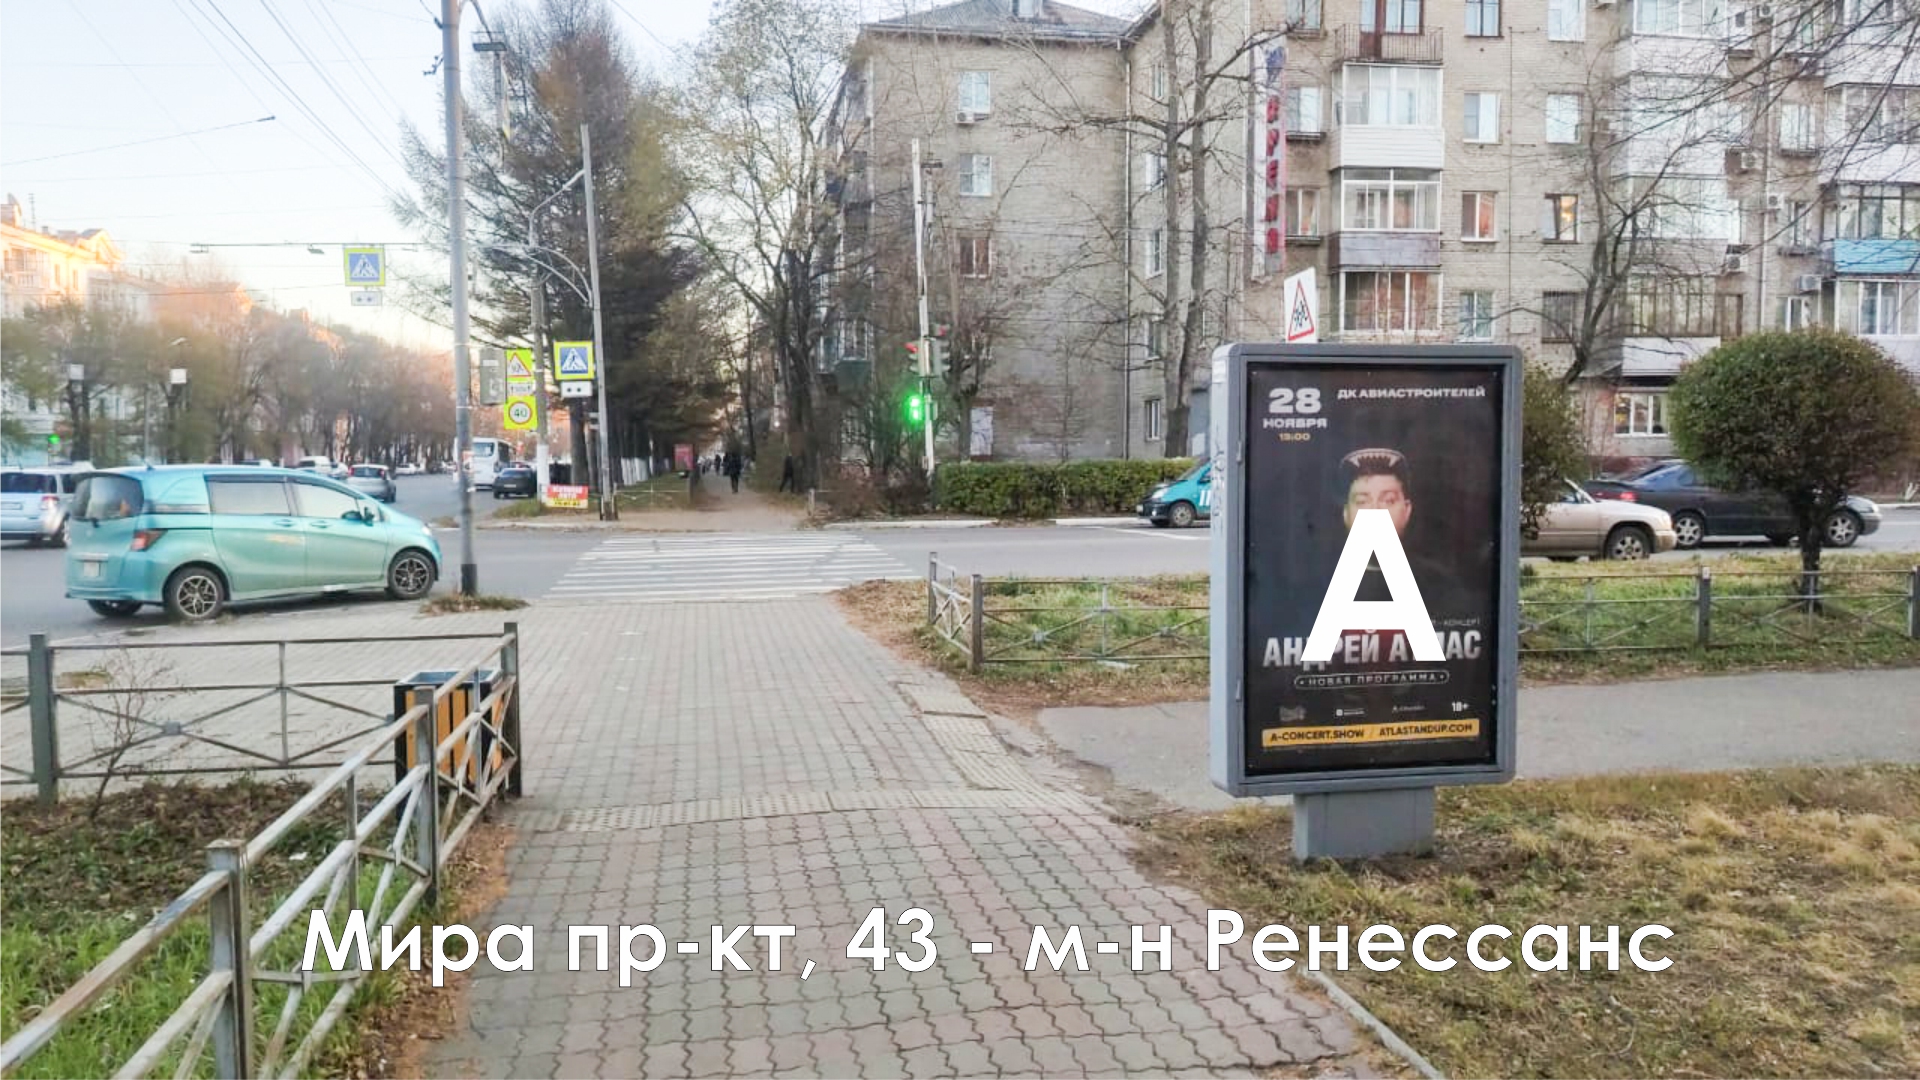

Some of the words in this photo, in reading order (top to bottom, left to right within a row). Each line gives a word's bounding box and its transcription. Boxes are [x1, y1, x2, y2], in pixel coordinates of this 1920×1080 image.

[1337, 388, 1358, 400] ДК
[1359, 385, 1486, 399] АВИАСТРОИТЕЛЕЙ
[1268, 387, 1322, 414] 28
[514, 408, 528, 418] 40
[1263, 417, 1328, 429] НОЯБРЯ
[1262, 629, 1380, 671] АНЕЙ
[1388, 629, 1482, 662] ААС
[1308, 676, 1351, 687] НОВАЯ
[1357, 673, 1436, 685] ПРОГРАММА
[1452, 701, 1469, 712] 18+
[1270, 728, 1365, 743] A-CONCERT.SHOW
[1379, 723, 1473, 737] ATLASTANDUP.COM
